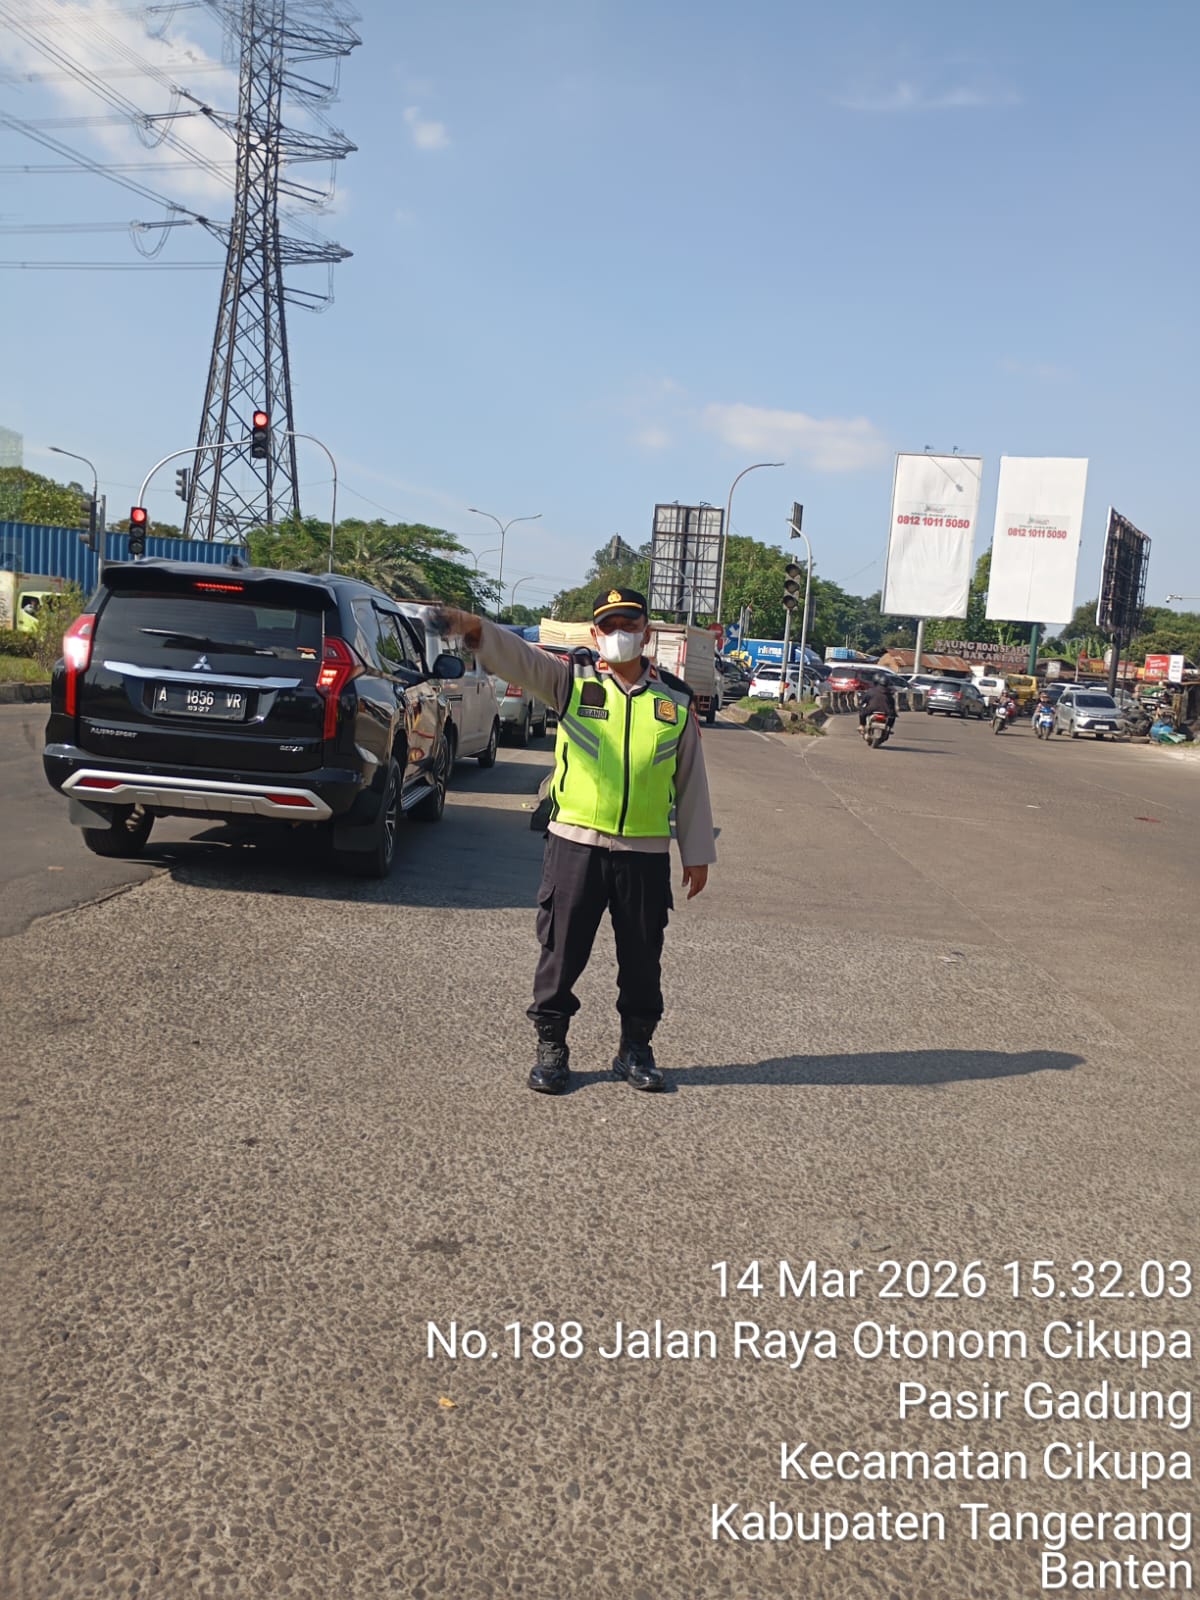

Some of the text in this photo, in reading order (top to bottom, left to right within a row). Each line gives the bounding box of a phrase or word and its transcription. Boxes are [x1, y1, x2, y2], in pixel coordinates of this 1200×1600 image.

[897, 515, 970, 529] 0812 1011 5050
[1008, 528, 1026, 536] 0812
[1028, 529, 1046, 538] 1011
[1046, 530, 1067, 539] 5050
[936, 640, 975, 650] SAUNG
[159, 686, 241, 708] A 1856 VR
